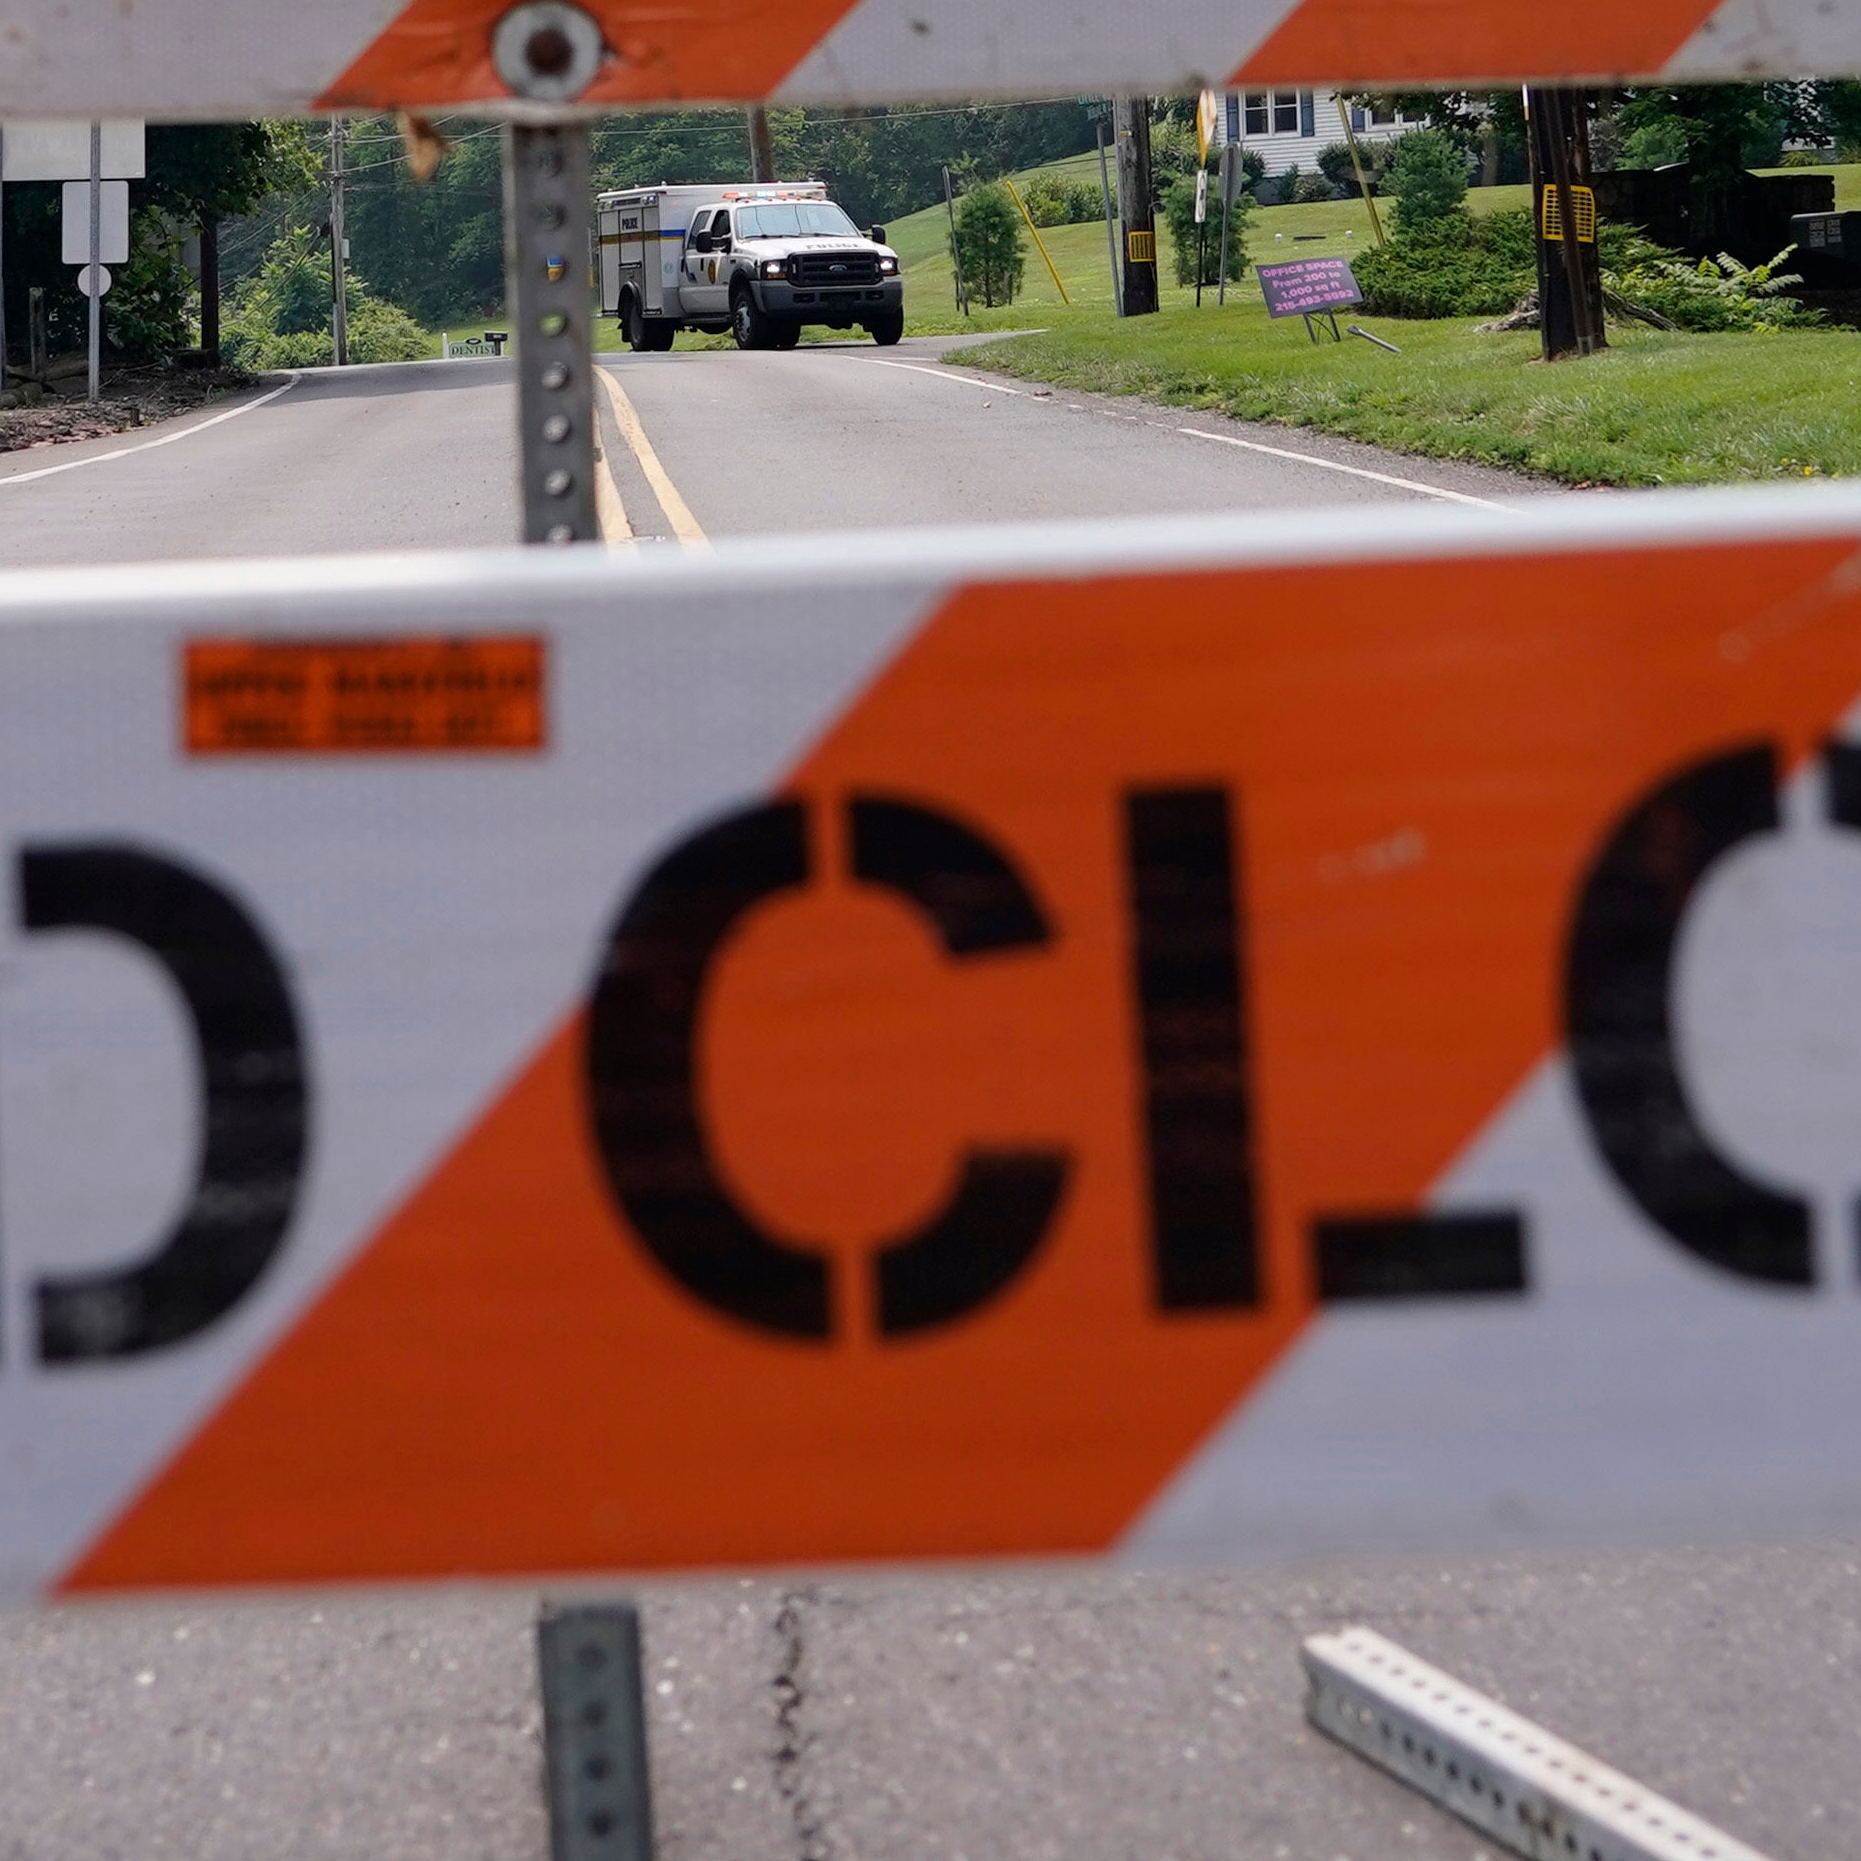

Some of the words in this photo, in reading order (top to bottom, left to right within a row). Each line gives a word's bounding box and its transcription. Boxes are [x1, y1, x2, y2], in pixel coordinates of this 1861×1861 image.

[1262, 264, 1305, 278] OFFICE
[1305, 260, 1344, 272] SPACE
[1272, 277, 1303, 289] From
[1304, 272, 1327, 283] 200
[1281, 285, 1313, 299] 1,000
[1314, 283, 1329, 292] sq
[1330, 281, 1341, 289] ft
